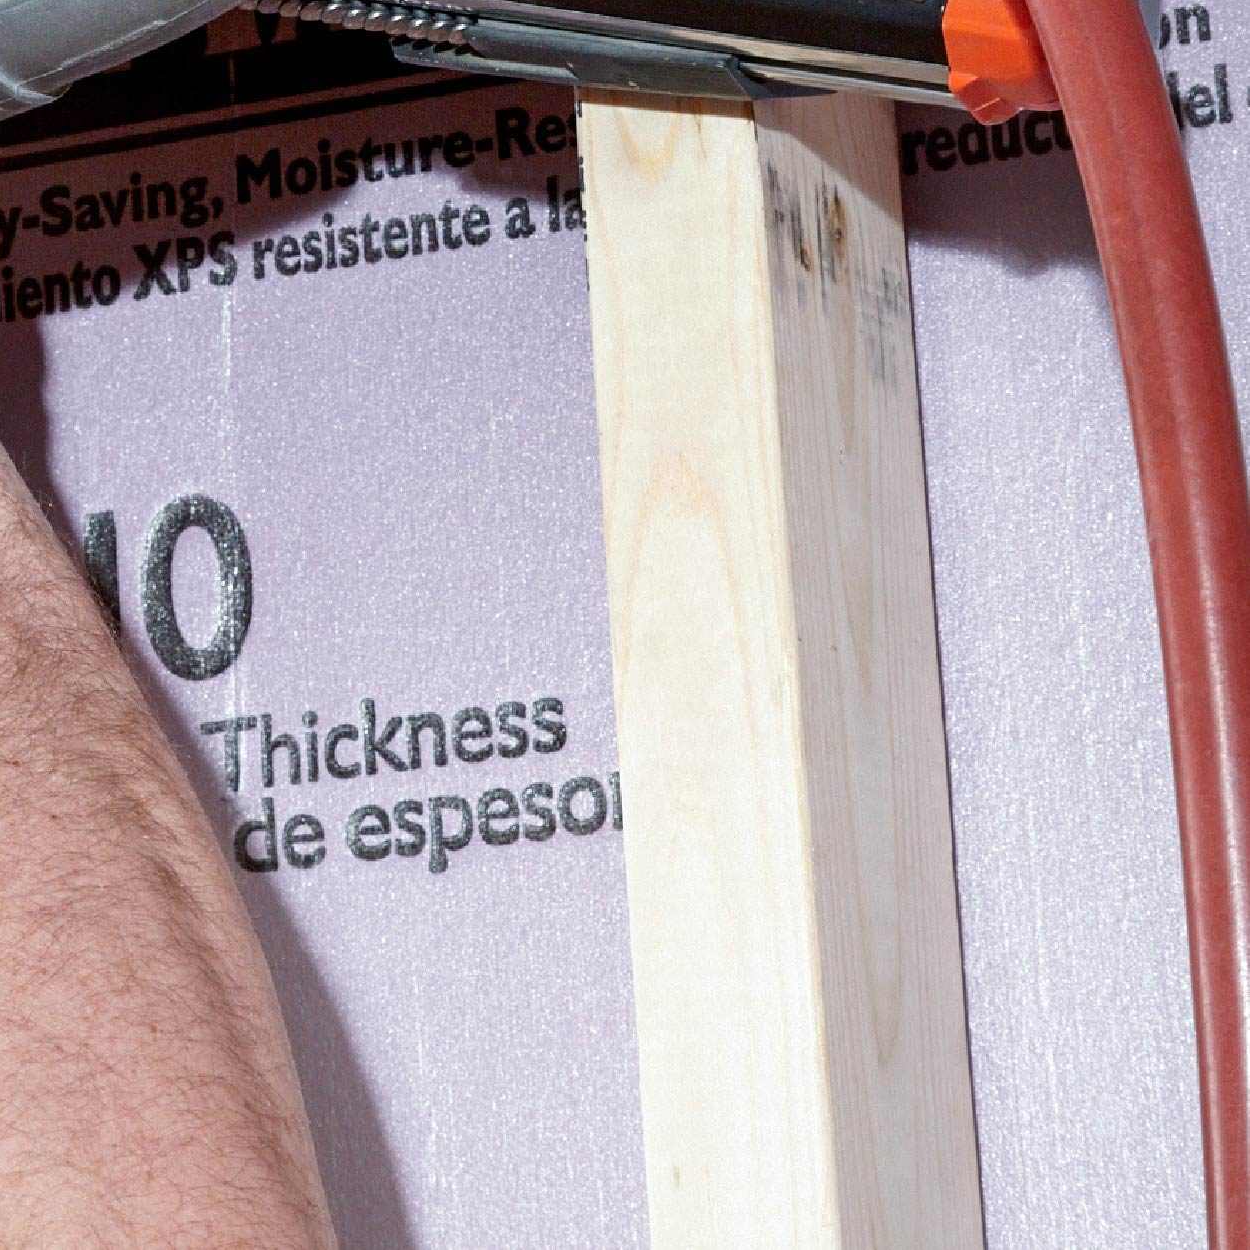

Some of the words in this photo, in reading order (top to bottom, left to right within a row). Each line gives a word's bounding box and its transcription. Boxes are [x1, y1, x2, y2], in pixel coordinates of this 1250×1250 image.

[133, 231, 238, 301] XPS
[253, 199, 491, 280] resistente
[504, 197, 537, 239] a
[200, 696, 568, 792] Thickness
[234, 796, 327, 873] de
